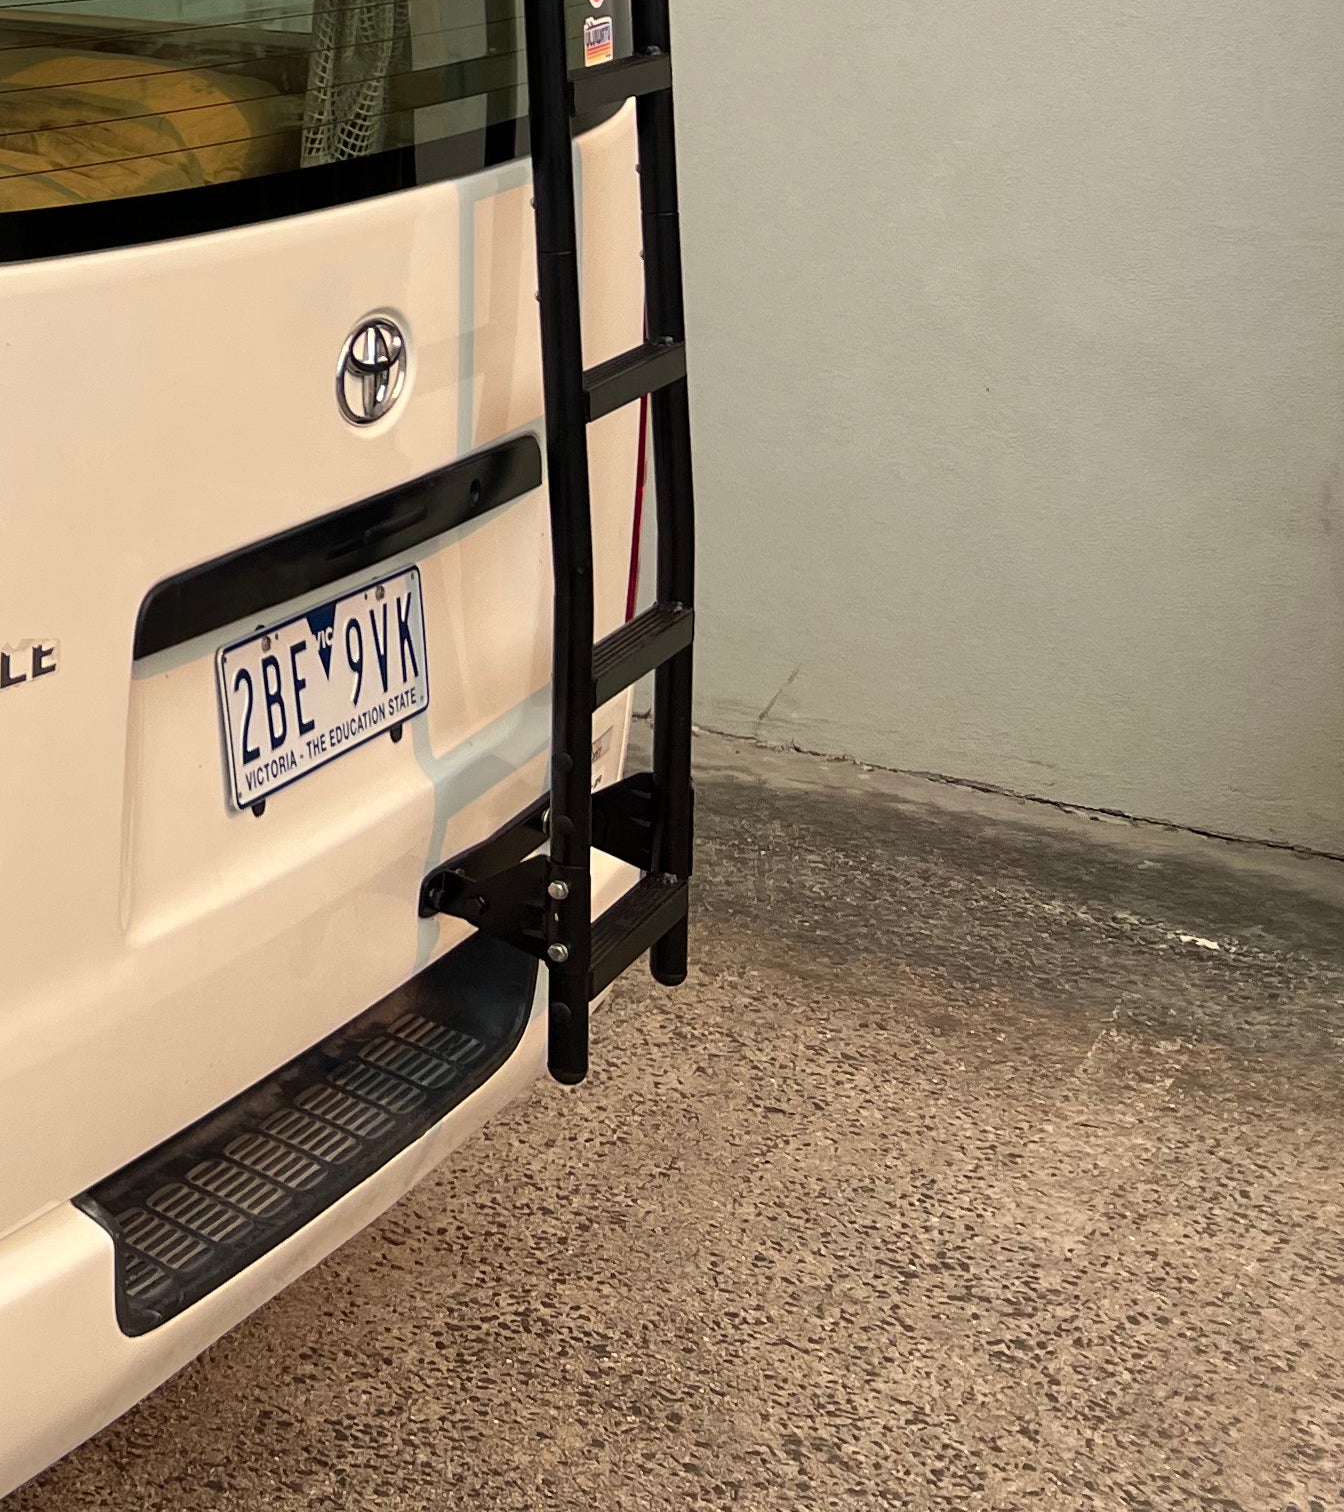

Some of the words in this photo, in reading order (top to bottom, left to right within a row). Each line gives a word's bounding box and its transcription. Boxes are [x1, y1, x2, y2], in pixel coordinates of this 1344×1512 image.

[234, 640, 315, 765] 2BE
[345, 592, 419, 707] 9VK
[245, 753, 298, 791] VICTORIA
[306, 733, 327, 759] THE
[329, 706, 386, 747] EDUCATION
[388, 687, 417, 716] STATE
